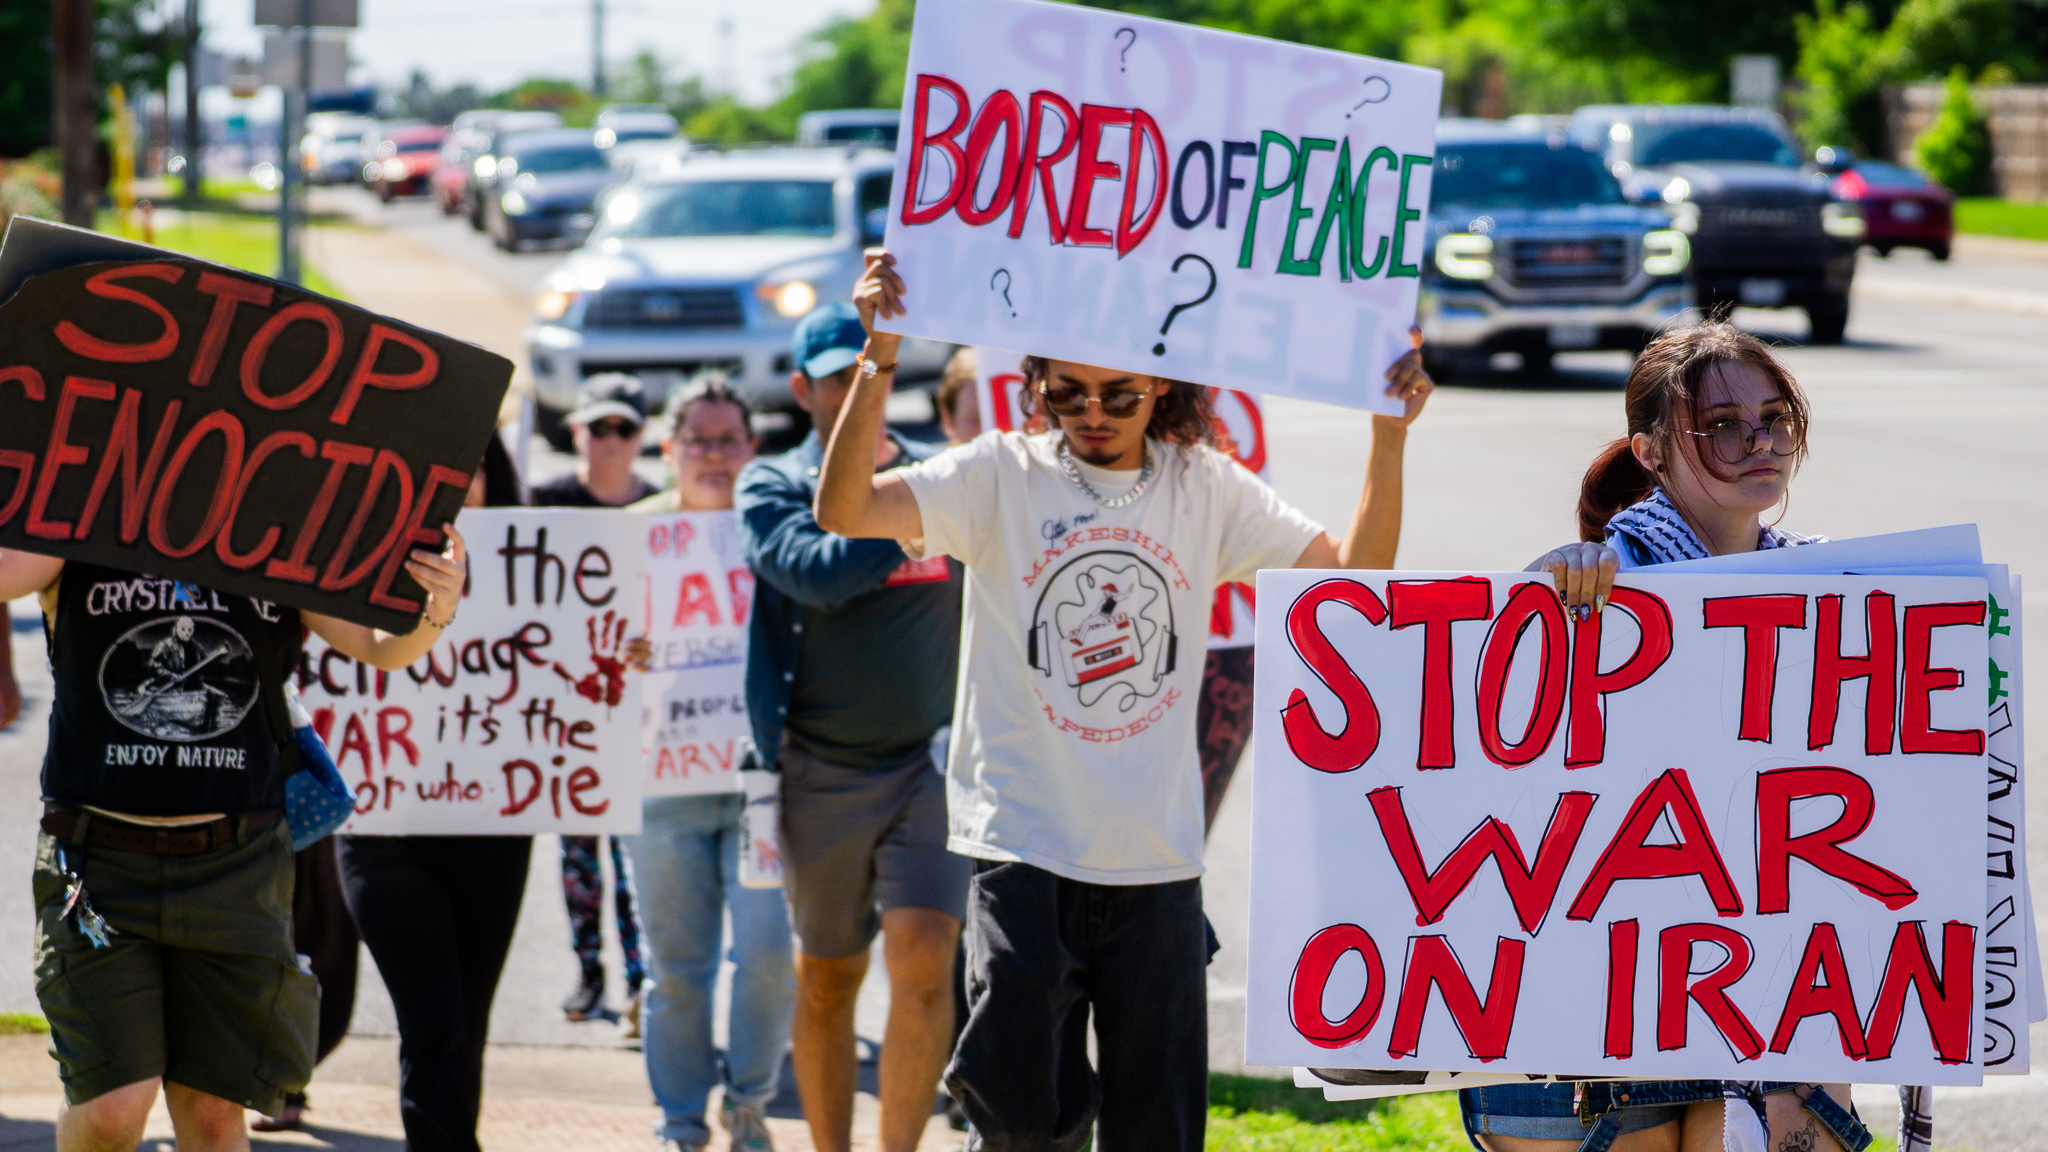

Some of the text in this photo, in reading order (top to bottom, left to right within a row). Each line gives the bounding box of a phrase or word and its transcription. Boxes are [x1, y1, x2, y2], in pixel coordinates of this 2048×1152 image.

[901, 73, 1170, 259] BORED
[1170, 139, 1257, 230] OF
[1237, 130, 1433, 282] PEACE
[55, 264, 439, 424] STOP
[497, 525, 617, 607] the
[1022, 527, 1191, 591] MAKESHIFT
[407, 622, 552, 706] wage
[1281, 576, 1987, 773] STOP THE
[105, 743, 247, 770] ENJOY NATURE
[438, 694, 502, 746] it's
[520, 698, 598, 752] the
[352, 755, 610, 819] or who Die
[1365, 766, 1918, 937] WAR
[1288, 917, 1977, 1065] ON IRAN
